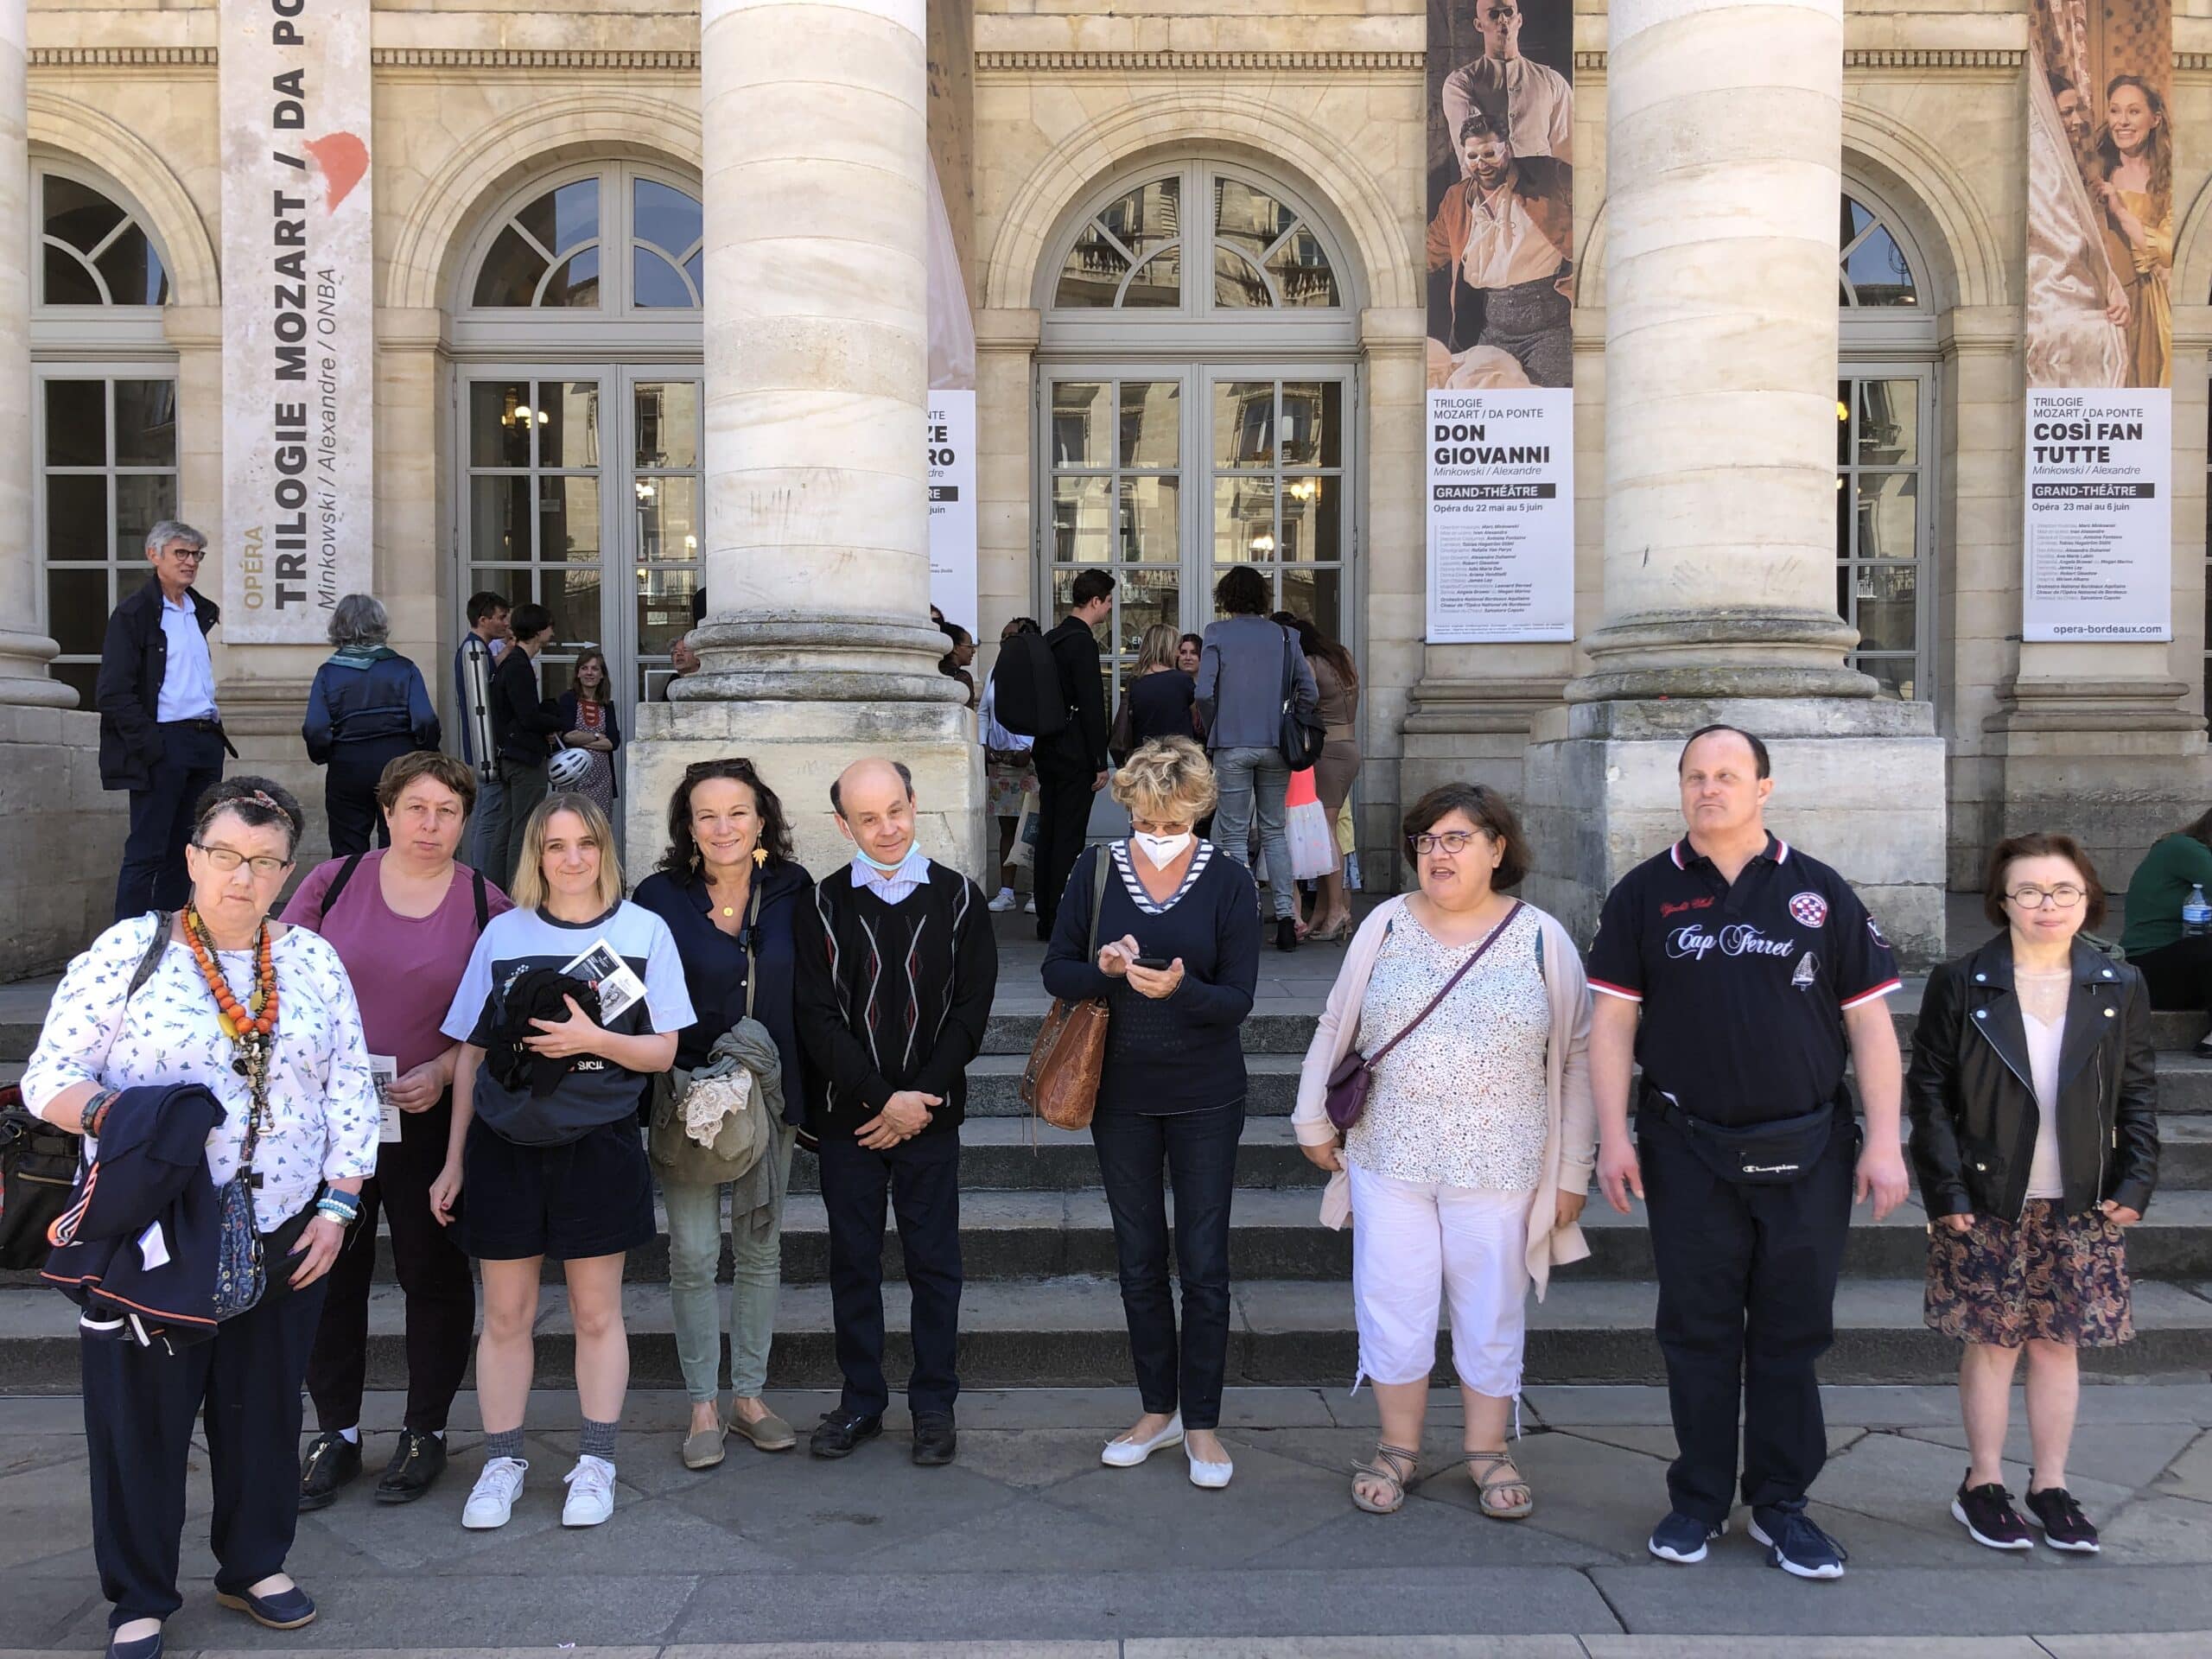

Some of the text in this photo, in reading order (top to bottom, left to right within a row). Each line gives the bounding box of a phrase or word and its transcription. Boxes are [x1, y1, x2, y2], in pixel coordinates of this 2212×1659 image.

[273, 68, 304, 129] DA
[274, 151, 306, 170] /
[274, 190, 306, 379] MOZART
[316, 270, 336, 334] ONBA
[1434, 399, 1483, 408] TRILOGIE
[2034, 397, 2083, 406] TRILOGIE
[318, 359, 336, 472] Alexandre
[1434, 409, 1543, 419] MOZART / DA PONTE
[2033, 409, 2143, 418] MOZART / DA PONTE
[1434, 425, 1484, 442] DON
[2034, 419, 2143, 441] COSÌ FAN
[1434, 447, 1549, 465] GIOVANNI
[2033, 447, 2110, 463] TUTTE
[1434, 467, 1484, 476] Minkowski
[1492, 466, 1541, 475] Alexandre
[2033, 466, 2084, 474] Minkowski
[2092, 465, 2140, 474] Alexandre
[1436, 484, 1538, 498] GRAND-THÉÂTRE
[2035, 483, 2137, 497] GRAND-THÉÂTRE
[275, 404, 307, 609] TRILOGIE
[929, 505, 945, 515] juin
[1433, 504, 1460, 514] Opéra
[1463, 504, 1474, 512] du
[1526, 504, 1543, 513] juin
[2032, 503, 2059, 512] Opéra
[2113, 503, 2130, 512] juin
[318, 494, 336, 609] Minkowski
[241, 526, 264, 609] OPÉRA
[2053, 625, 2162, 634] opera-bordeaux.com
[1665, 925, 1794, 960] Cap Ferret
